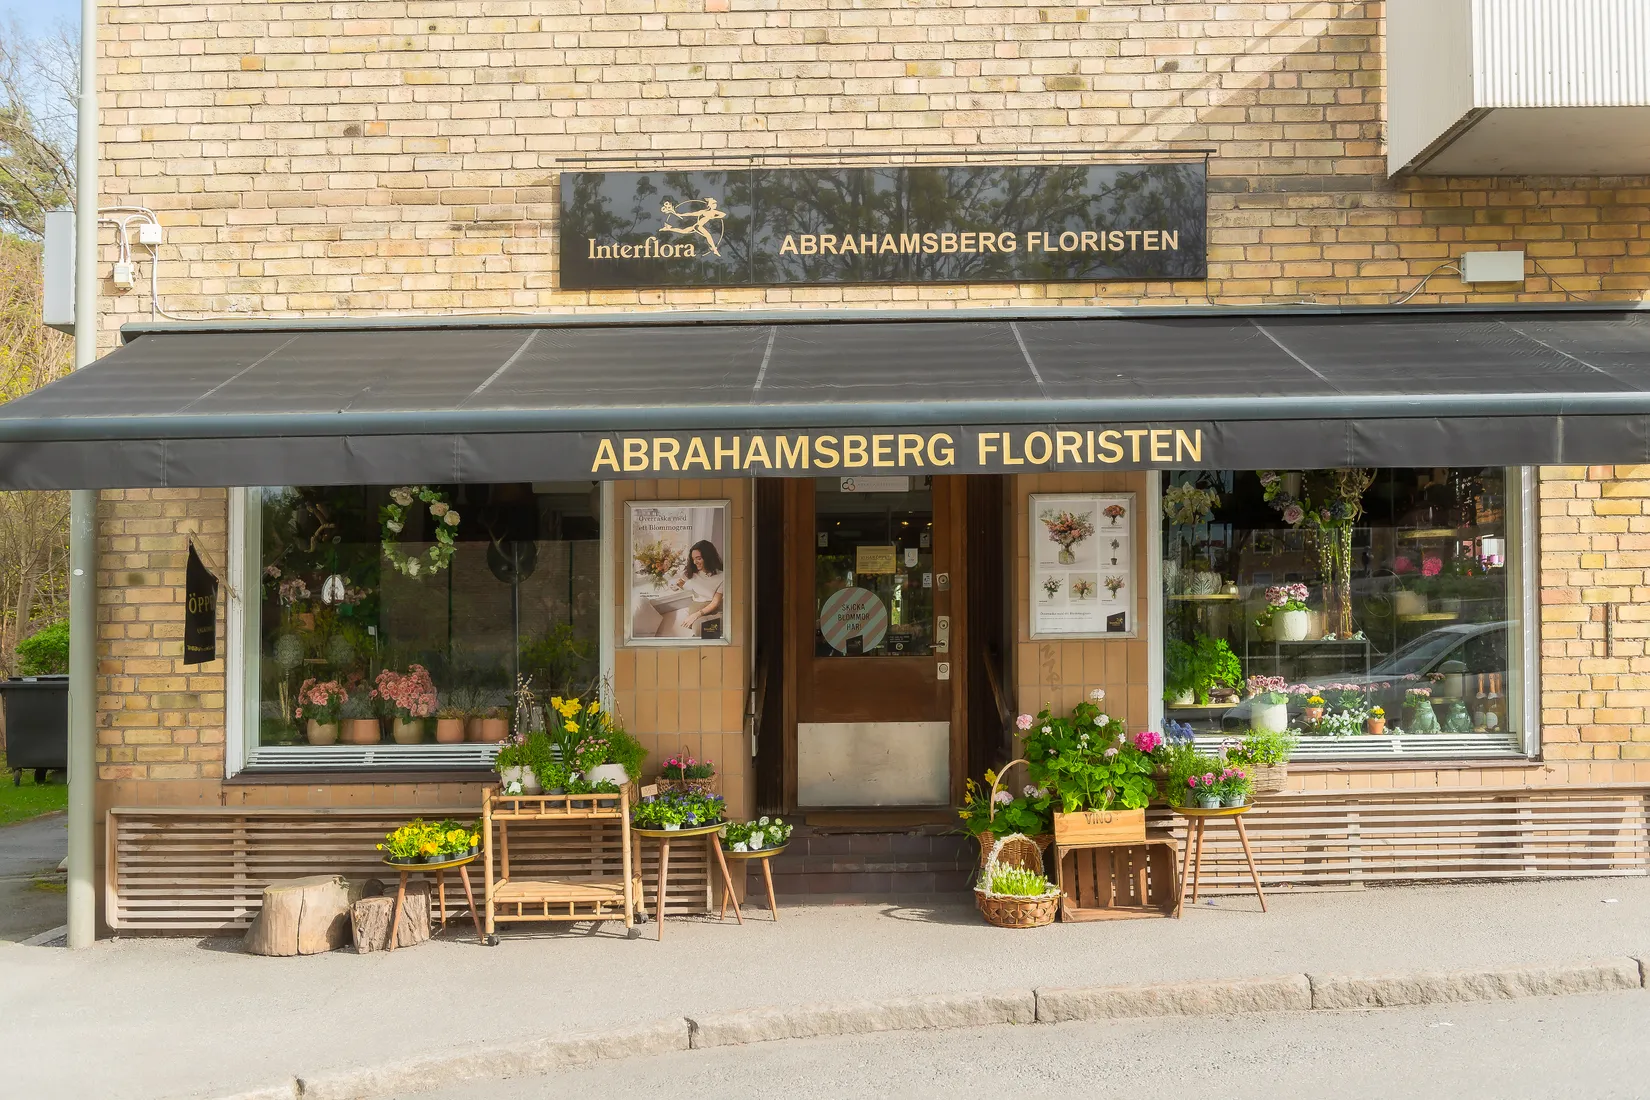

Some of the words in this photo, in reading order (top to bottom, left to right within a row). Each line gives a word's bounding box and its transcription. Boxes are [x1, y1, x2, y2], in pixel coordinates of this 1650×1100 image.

[588, 236, 696, 260] Interflora
[780, 231, 1018, 256] ABRAHAMSBERG
[1027, 229, 1179, 253] FLORISTEN
[591, 432, 956, 473] ABRAHAMSBERG
[978, 428, 1203, 466] FLORISTEN
[841, 603, 866, 611] SKICKA
[837, 613, 870, 621] BLOMMOR
[1084, 812, 1112, 825] VINO
